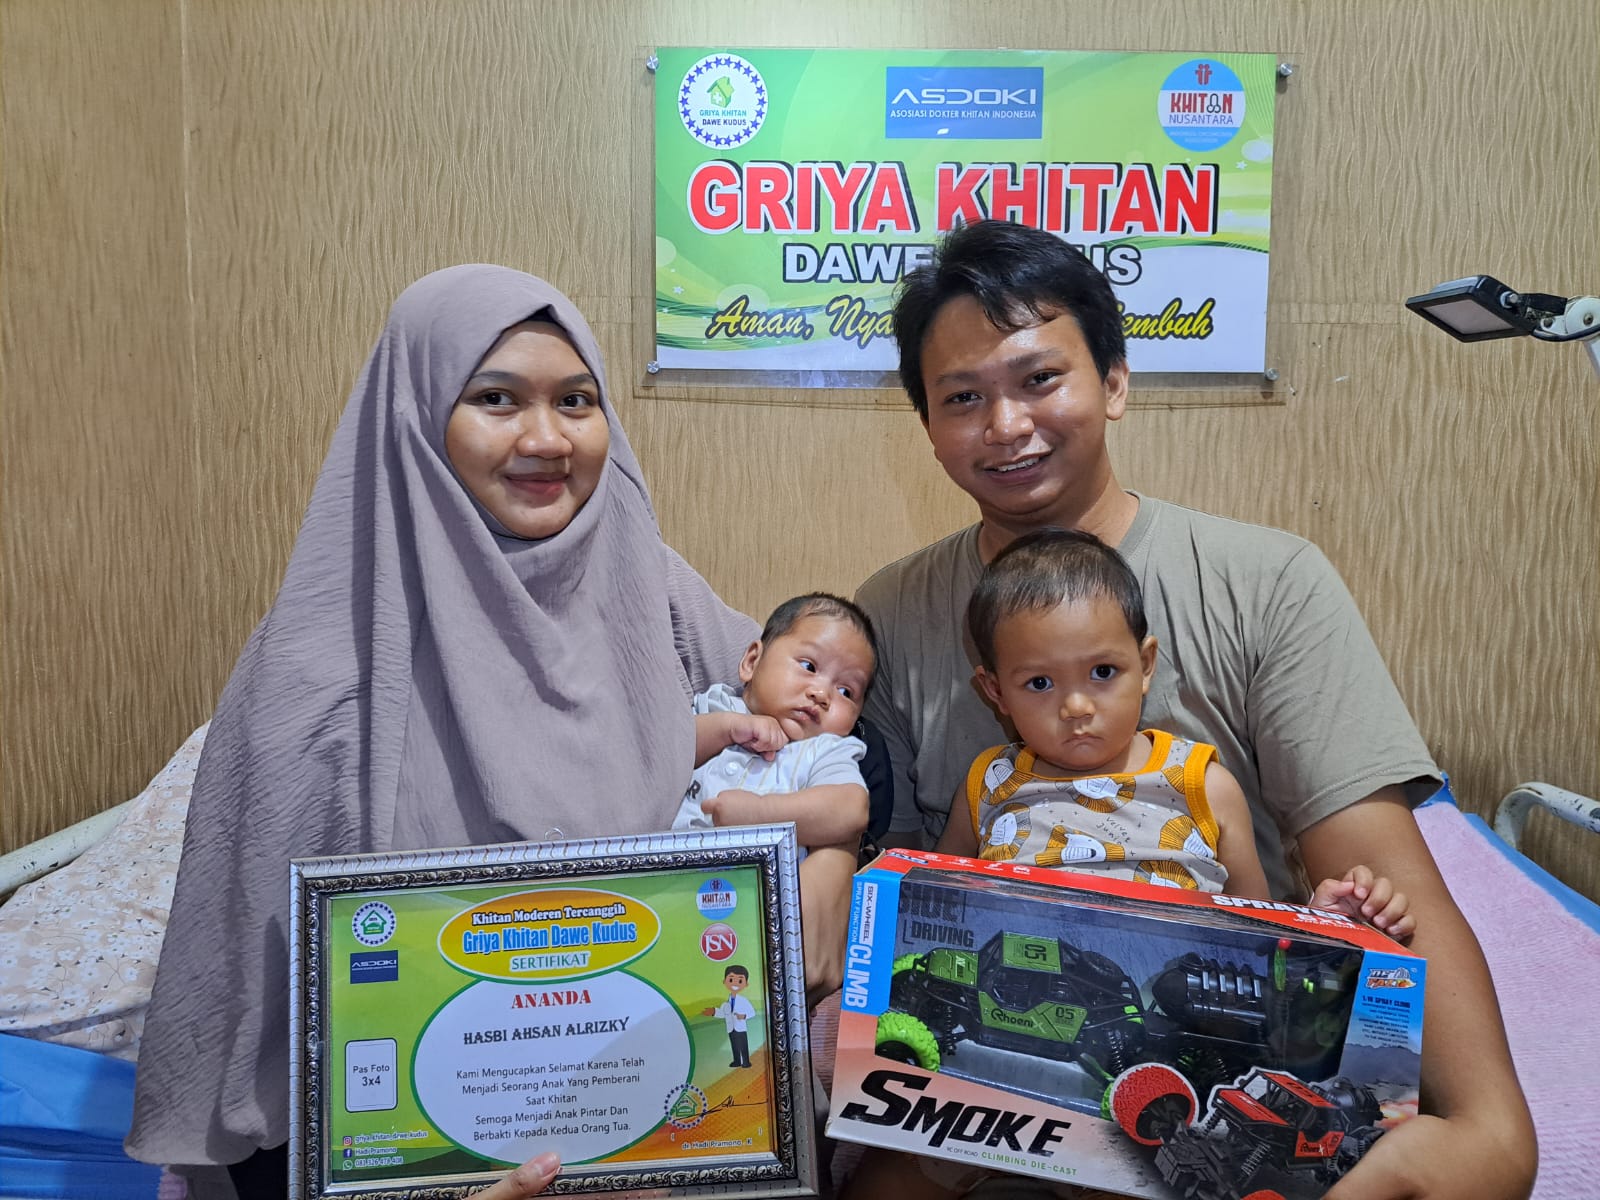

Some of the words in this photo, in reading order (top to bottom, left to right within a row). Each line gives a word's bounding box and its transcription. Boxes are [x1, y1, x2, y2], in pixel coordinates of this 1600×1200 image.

[891, 88, 1037, 105] ASDOKI
[699, 109, 720, 117] GRIYA
[722, 109, 747, 117] KHITAN
[702, 118, 721, 126] DAWE
[723, 118, 747, 126] KUDUS
[890, 109, 927, 118] ASOSIASI
[929, 110, 959, 118] DOKTER
[961, 110, 990, 119] KHITAN
[992, 110, 1037, 119] INDONESIA
[1169, 114, 1234, 125] NUSANTARA
[687, 160, 919, 234] GRIYA
[935, 162, 1220, 237] KHITAN
[705, 294, 814, 340] Aman,
[1117, 298, 1215, 340] embuh
[472, 912, 512, 926] Khitan
[514, 908, 562, 923] Moderen
[564, 903, 626, 919] Tercanggih
[863, 886, 874, 941] SIX-WHEEL
[852, 907, 860, 943] FUNCTION
[911, 920, 974, 948] DRIVING
[463, 930, 500, 954] Griya
[503, 927, 549, 950] Khitan
[551, 925, 589, 947] Dawe
[592, 921, 637, 944] Kudus
[511, 953, 589, 970] SERTIFIKAT
[845, 944, 873, 1008] CLIMB
[511, 989, 592, 1009] ANANDA
[1055, 1006, 1075, 1020] 05
[463, 1029, 507, 1045] HASBI
[511, 1025, 561, 1041] AHSAN
[565, 1016, 630, 1036] ALRIZKY
[352, 1065, 368, 1074] Pas
[371, 1064, 390, 1073] Foto
[456, 1069, 479, 1079] Kami
[482, 1066, 546, 1080] Mengucapkan
[548, 1062, 585, 1073] Selamat
[587, 1059, 618, 1070] Karena
[621, 1057, 644, 1067] Telah
[362, 1075, 381, 1087] 3x4
[462, 1083, 499, 1096] Menjadi
[501, 1081, 539, 1093] Seorang
[541, 1078, 564, 1089] Anak
[567, 1078, 589, 1090] Yang
[591, 1073, 640, 1086] Pemberani
[525, 1096, 545, 1106] Saat
[548, 1094, 577, 1104] Khitan
[475, 1114, 512, 1126] Semoga
[515, 1110, 552, 1123] Menjadi
[554, 1109, 578, 1119] Anak
[580, 1107, 607, 1117] Pintar
[610, 1106, 628, 1115] Dan
[838, 1069, 1072, 1158] SMOKE
[473, 1129, 511, 1141] Berbakti
[514, 1127, 548, 1140] Kepada
[550, 1125, 579, 1135] Kedua
[581, 1123, 610, 1135] Orang
[612, 1121, 631, 1132] Tua.
[981, 1151, 1027, 1166] CLIMBING
[1031, 1161, 1078, 1176] DIE-CAST
